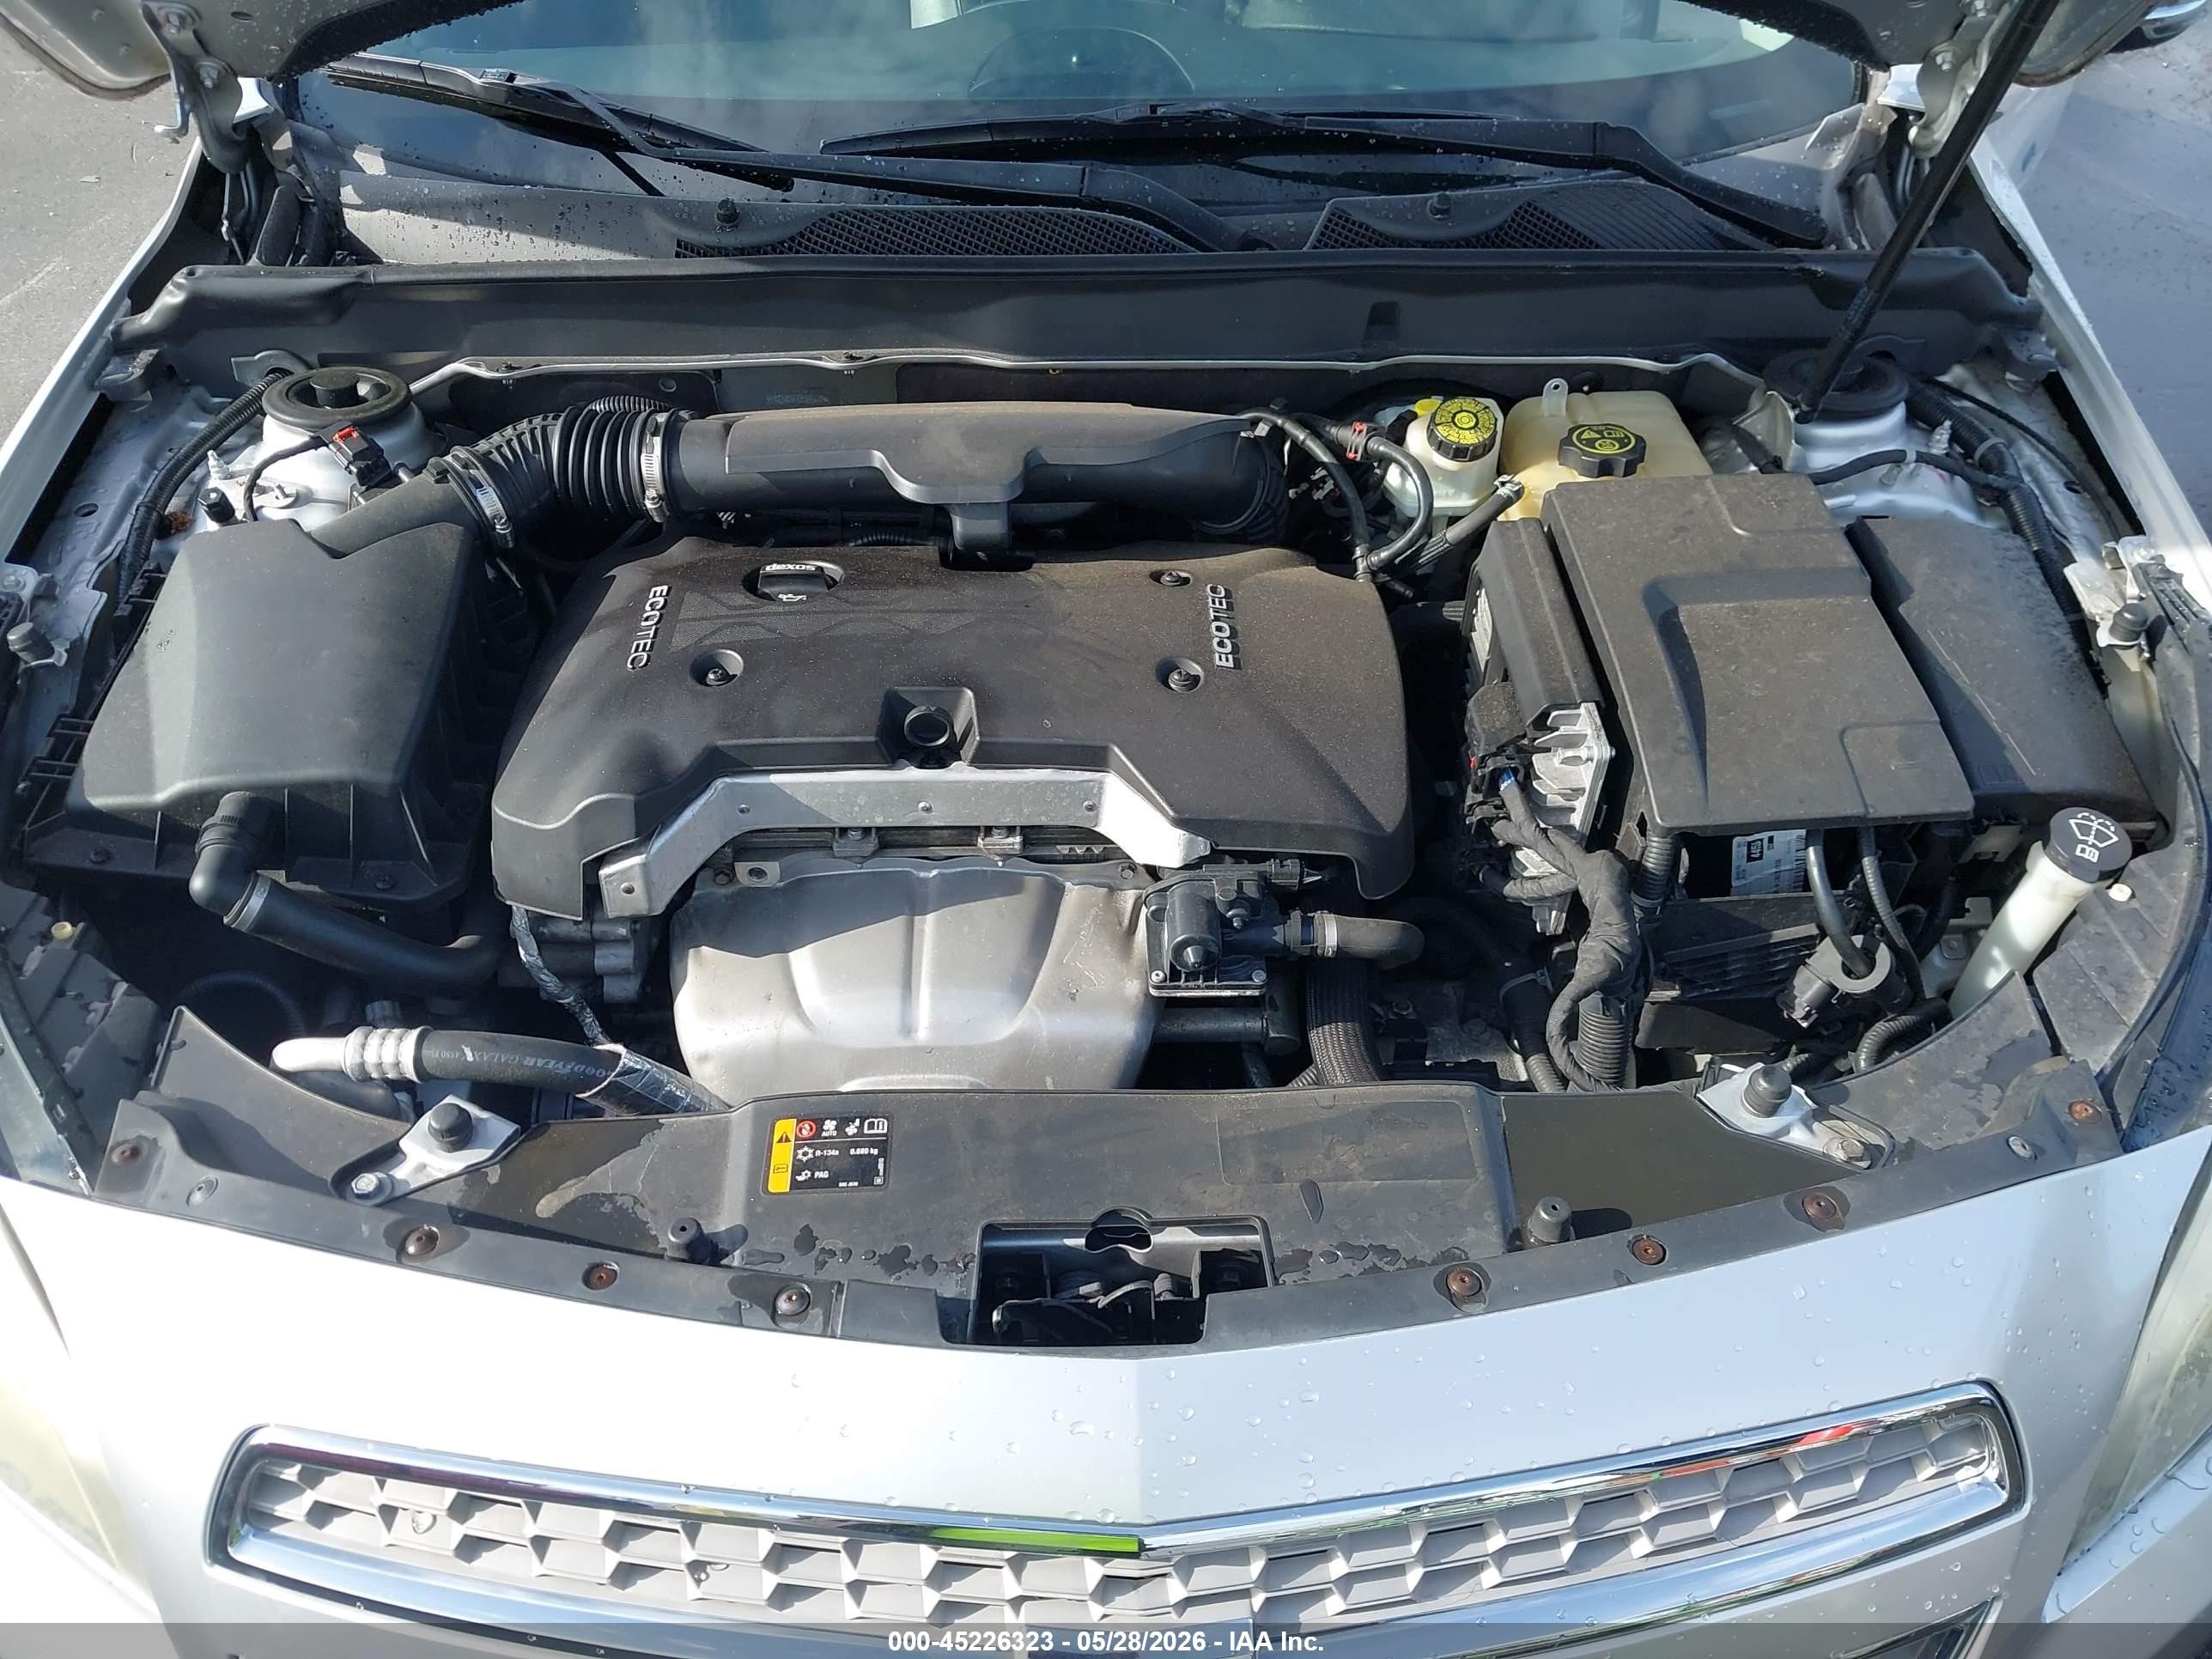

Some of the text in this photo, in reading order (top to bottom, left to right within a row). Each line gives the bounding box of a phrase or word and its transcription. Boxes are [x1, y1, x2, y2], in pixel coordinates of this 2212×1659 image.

[626, 585, 669, 670] ECOTEC
[1206, 584, 1235, 667] ECOTEC
[814, 1170, 830, 1179] PAG
[870, 1147, 878, 1156] kg
